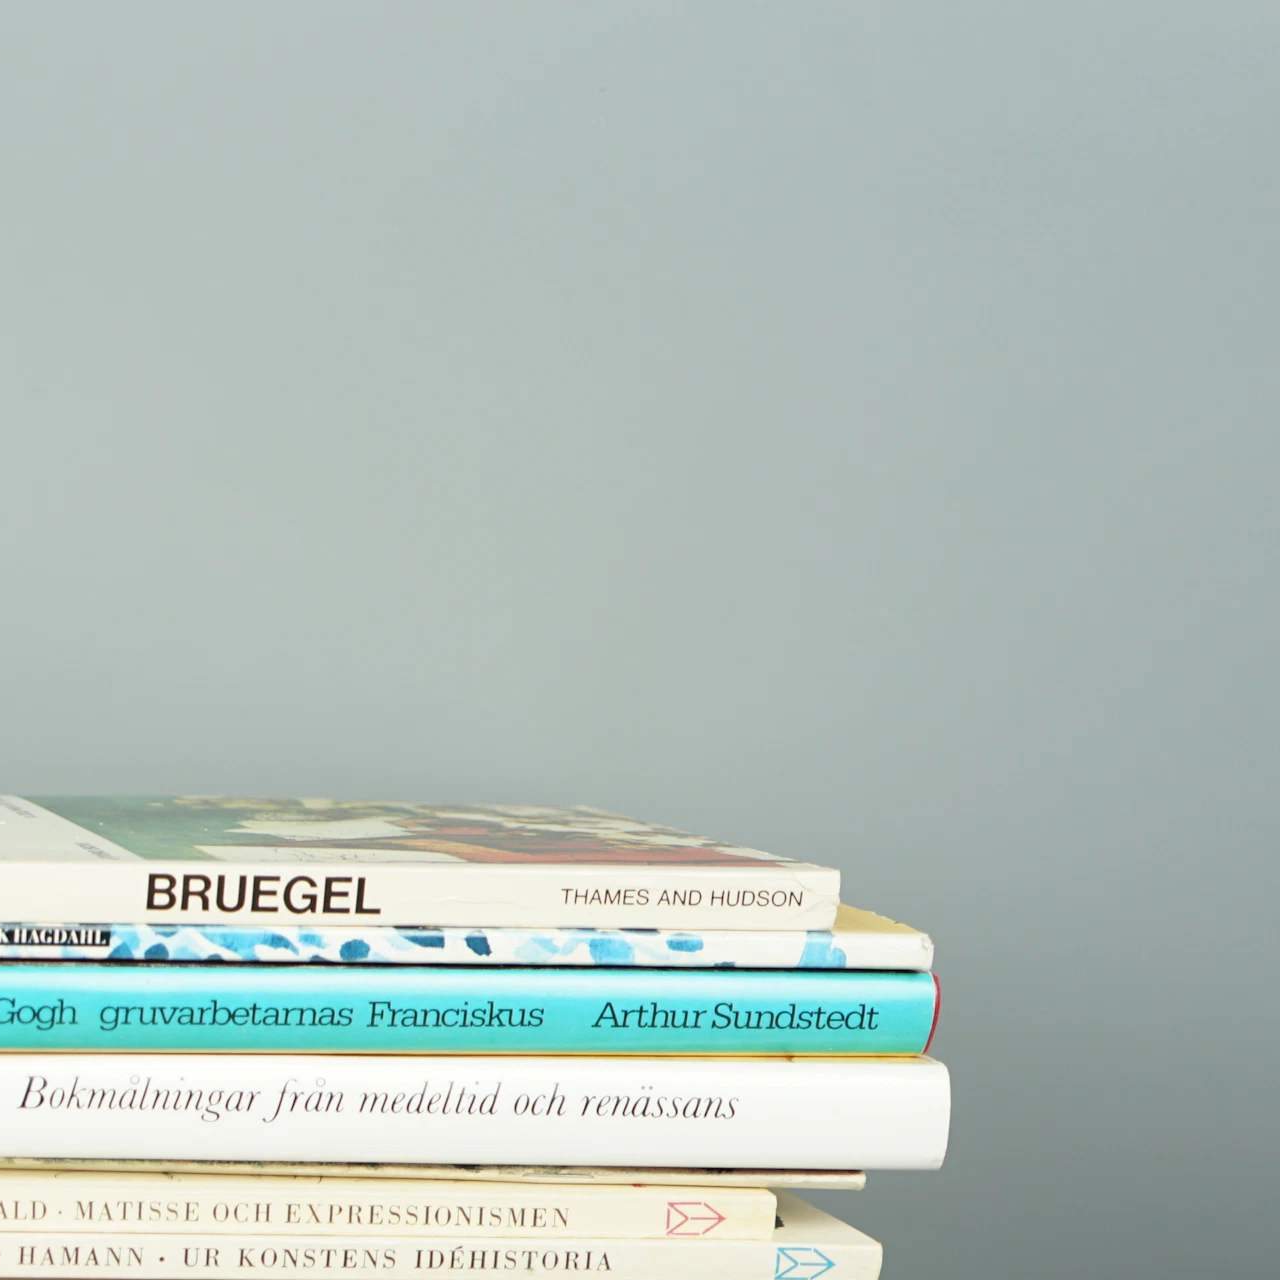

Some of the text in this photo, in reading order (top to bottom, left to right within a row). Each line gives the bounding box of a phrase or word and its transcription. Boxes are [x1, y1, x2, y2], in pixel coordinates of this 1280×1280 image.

[146, 873, 382, 915] BRUEGEL
[561, 888, 804, 908] THAMES AND HUDSON
[14, 927, 108, 946] HAGDAHL
[99, 1000, 353, 1031] gruvarbetarnas
[367, 1001, 544, 1029] Franciskus
[591, 1002, 707, 1031] Arthur
[711, 1003, 878, 1032] Sundstedt
[17, 1073, 261, 1122] Bokmålningar
[263, 1077, 344, 1123] från
[359, 1081, 499, 1118] medeltid
[514, 1083, 566, 1118] och
[581, 1086, 739, 1120] renässans
[75, 1200, 200, 1222] MATISSE
[212, 1202, 272, 1224] OCH
[284, 1203, 571, 1229] EXPRESSIONISMEN
[18, 1245, 145, 1267] HAMANN
[183, 1247, 220, 1268] UR
[238, 1248, 397, 1270] KONSTENS
[414, 1245, 613, 1271] IDÉHISTORIA
